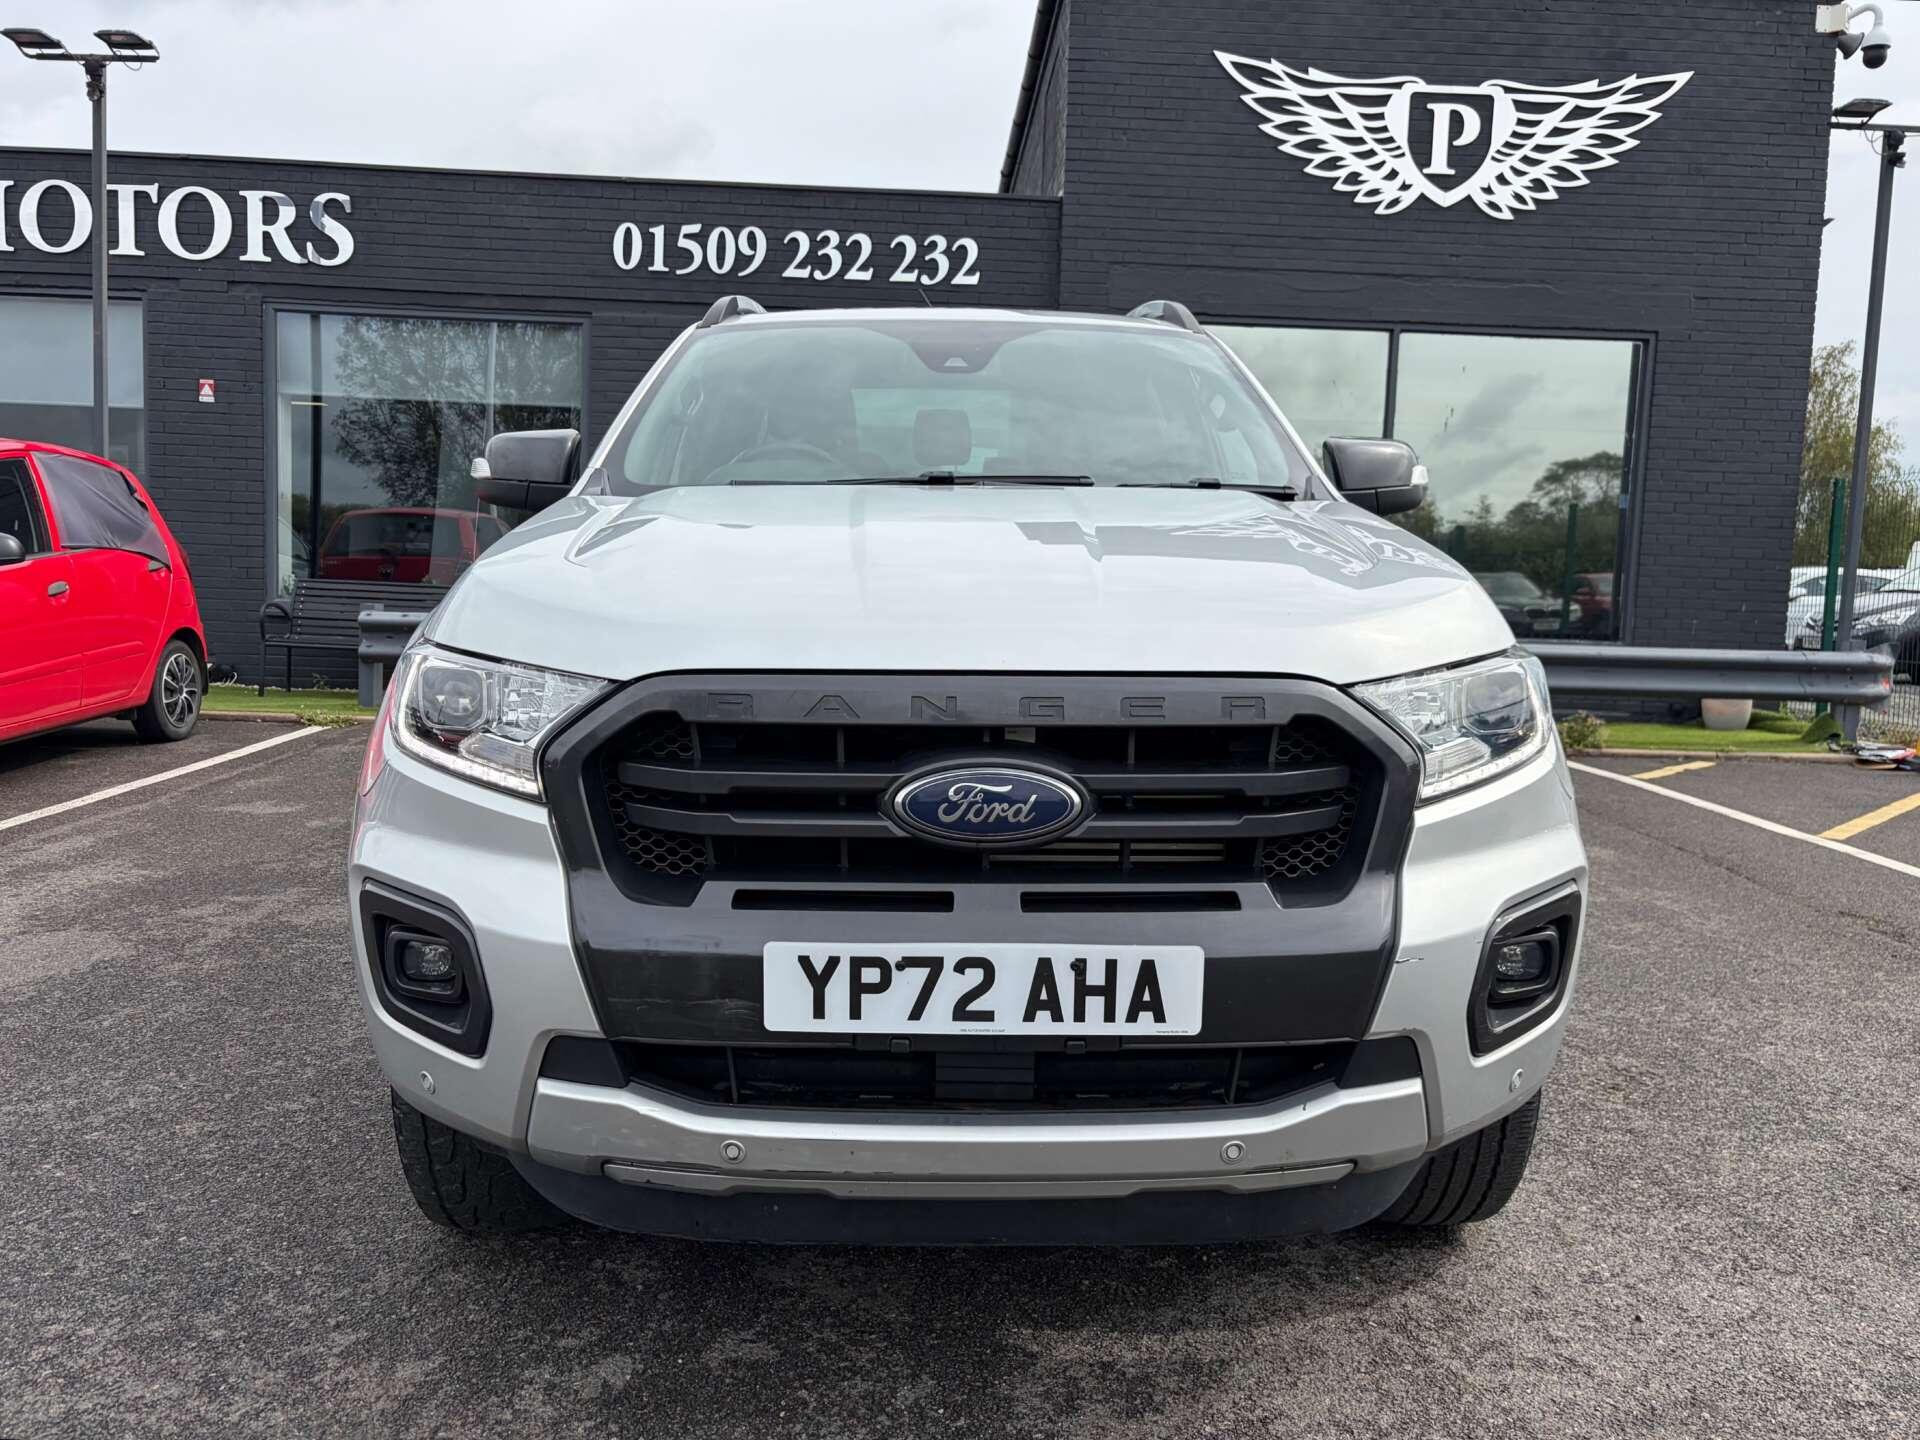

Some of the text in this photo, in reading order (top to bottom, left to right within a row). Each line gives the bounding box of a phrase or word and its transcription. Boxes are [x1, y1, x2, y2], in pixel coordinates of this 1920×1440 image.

[1421, 102, 1482, 176] P
[0, 179, 355, 267] OTORS
[612, 221, 981, 286] 01509 232 232
[705, 692, 1267, 721] RANGER
[936, 781, 1037, 825] Ford
[797, 954, 1168, 1024] YP72 AHA
